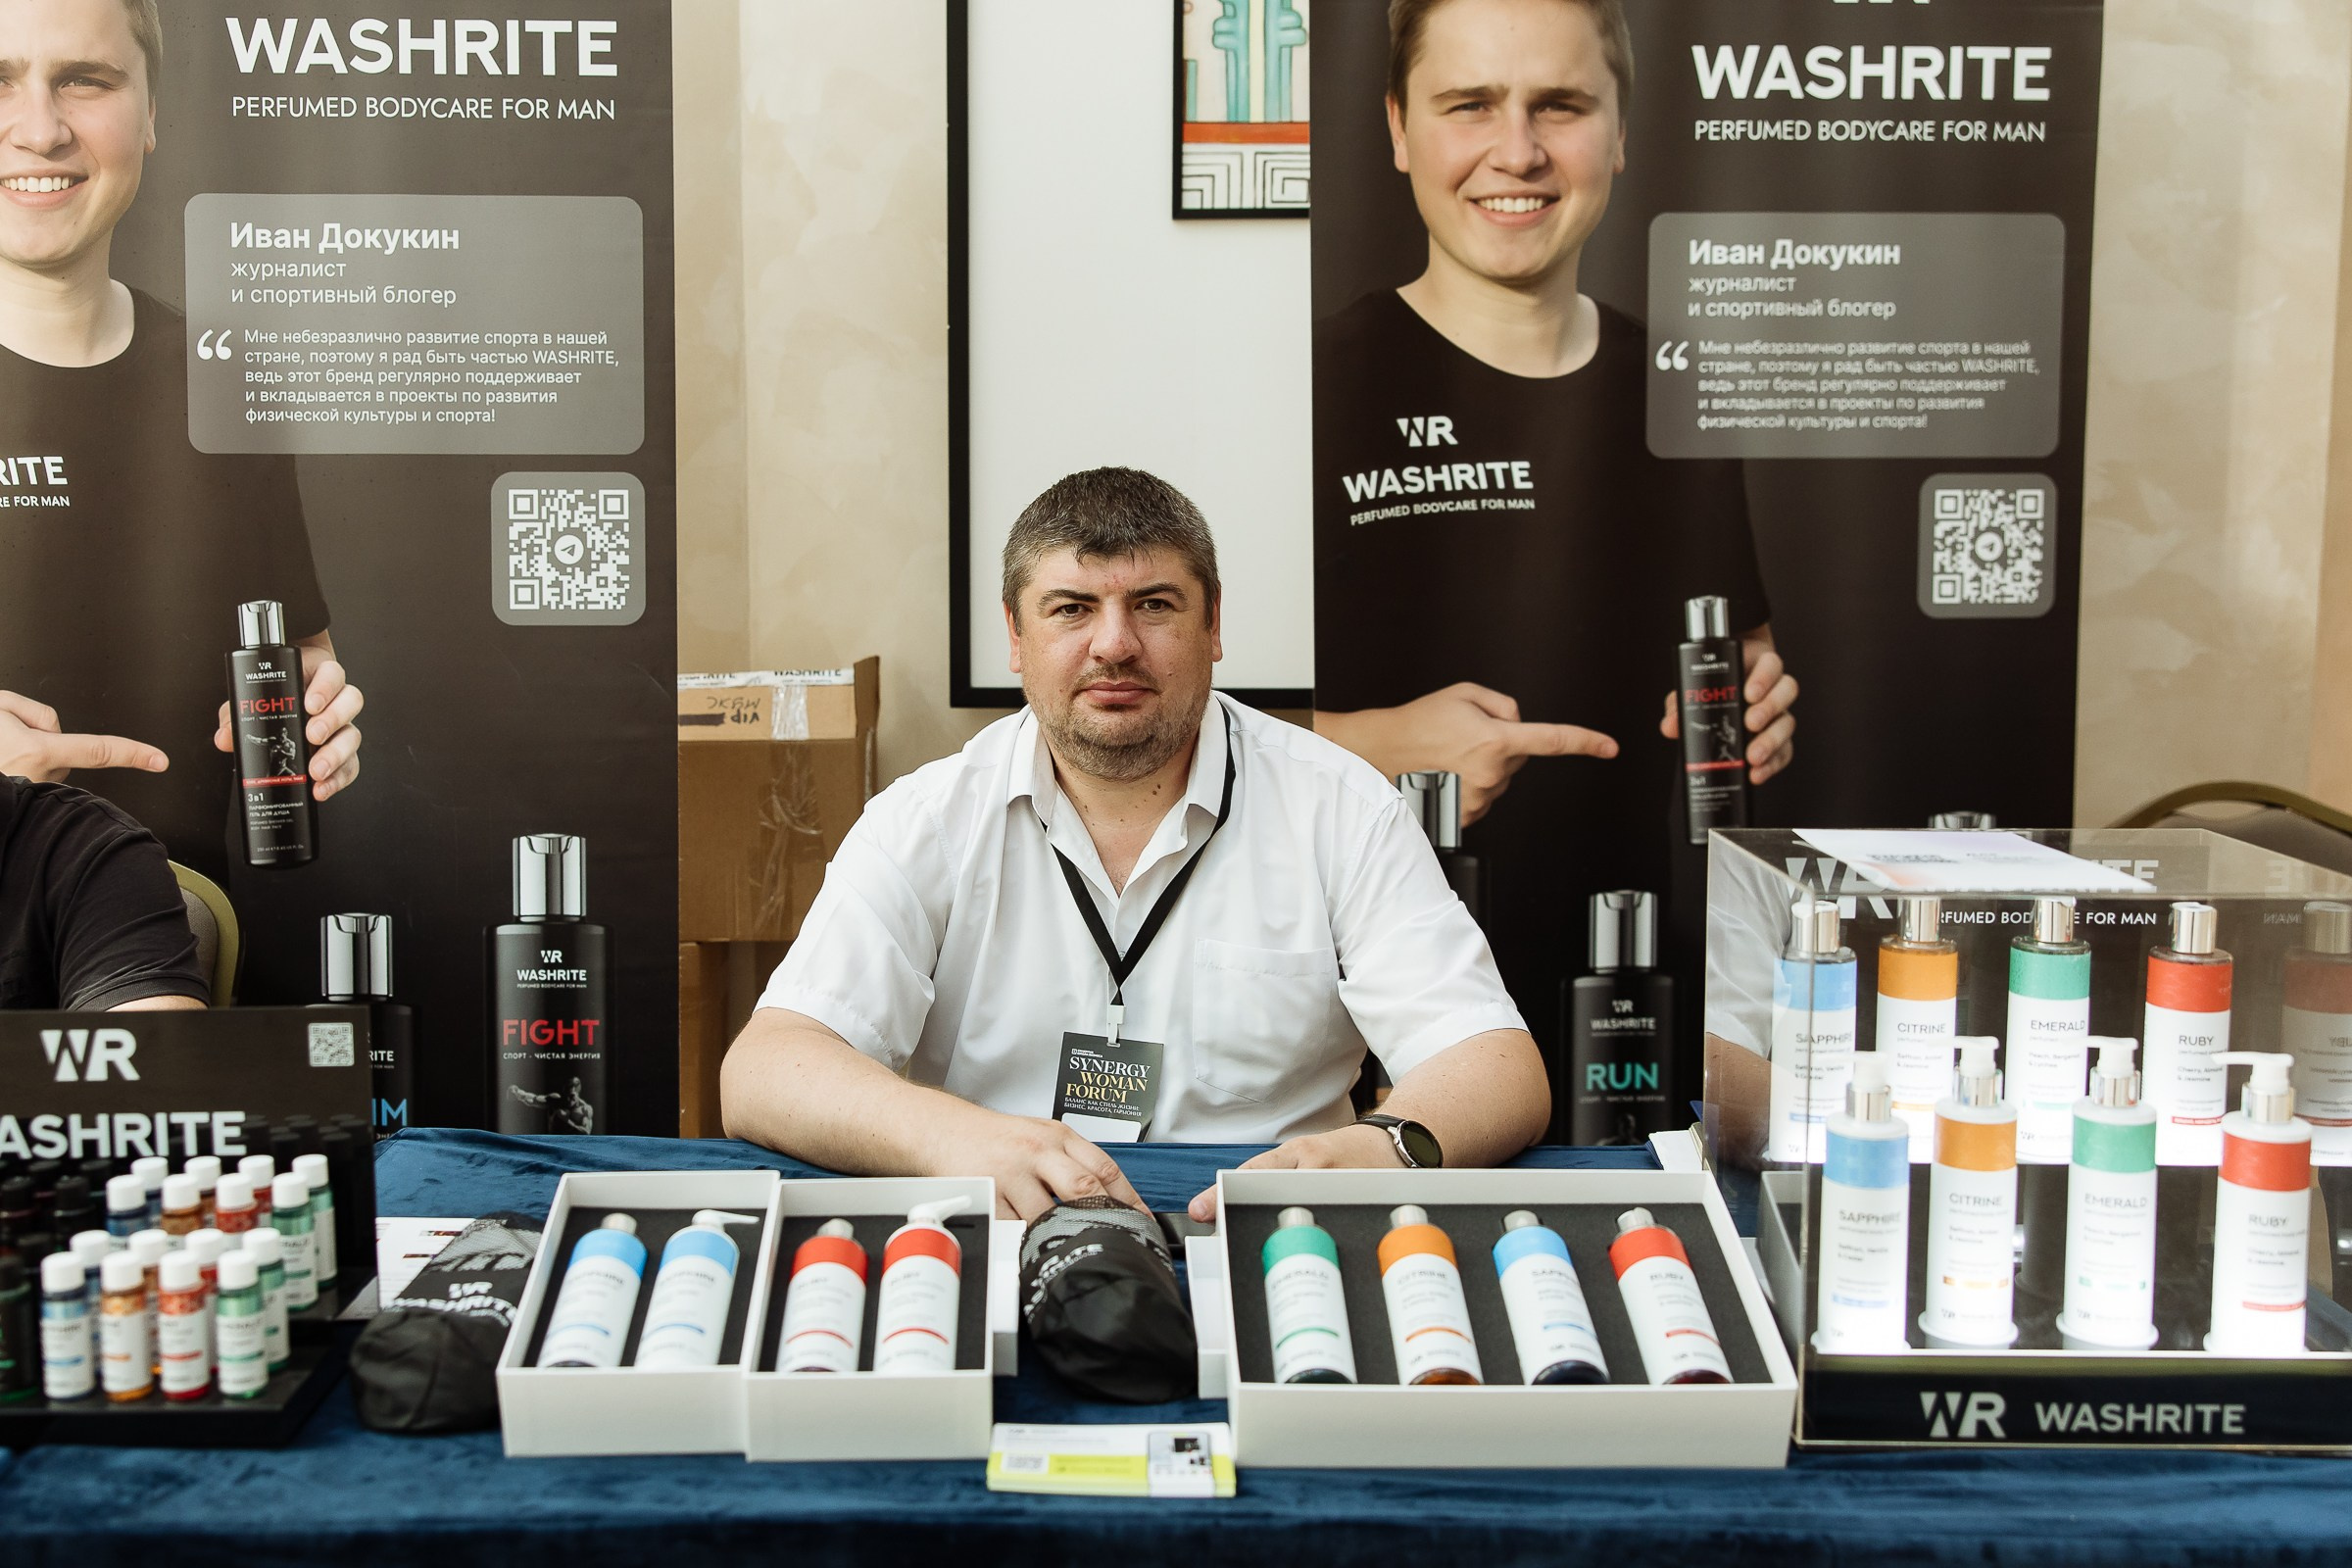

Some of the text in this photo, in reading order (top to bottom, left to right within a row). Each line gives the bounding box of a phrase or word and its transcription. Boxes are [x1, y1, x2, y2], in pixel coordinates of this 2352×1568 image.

[225, 17, 618, 76] WASHRITE
[1690, 45, 2052, 101] WASHRITE
[232, 96, 615, 121] PERFUMED BODYCARE FOR MAN
[1694, 120, 2046, 143] PERFUMED BODYCARE FOR MAN
[230, 221, 460, 255] Иван Докукин
[1689, 238, 1901, 271] Иван Докукин
[231, 262, 347, 281] журналист
[1688, 277, 1797, 296] журналист
[231, 285, 458, 308] и спортивный блогер
[1688, 298, 1897, 320] и спортивный блогер
[245, 329, 608, 348] Мне небезразлично развитие спорта в нашей
[245, 350, 619, 367] стране, поэтому я рад быть частью WASHRITE,
[245, 369, 582, 386] ведь этот бренд регулярно поддерживает
[245, 391, 558, 406] и вкладывается в проекты по развития
[245, 408, 496, 425] физической культуры и спорта!
[1396, 416, 1458, 447] WR
[1342, 461, 1534, 504] WASHRITE
[14, 495, 39, 507] FOR
[40, 495, 71, 507] MAN
[1350, 505, 1411, 526] PERFUMED
[1481, 498, 1506, 510] FOR
[1507, 498, 1536, 510] MAN
[245, 670, 287, 681] WASHRITE
[1685, 687, 1738, 703] FIGHT
[239, 697, 296, 714] FIGHT
[2085, 911, 2115, 925] FOR
[2121, 912, 2156, 925] MAN
[540, 950, 563, 963] WR
[516, 969, 587, 981] WASHRITE
[503, 1019, 600, 1046] FIGHT
[1590, 1017, 1657, 1030] WASHRITE
[1897, 1022, 1946, 1034] CITRINE
[2031, 1020, 2085, 1032] EMERALD
[2179, 1035, 2214, 1047] RUBY
[39, 1028, 141, 1082] WR
[1069, 1055, 1152, 1078] SYNERGY
[1080, 1070, 1149, 1092] WOMAN
[1586, 1062, 1658, 1091] RUN
[1065, 1083, 1128, 1103] FORUM
[1919, 1392, 2245, 1438] WR WASHRITE
